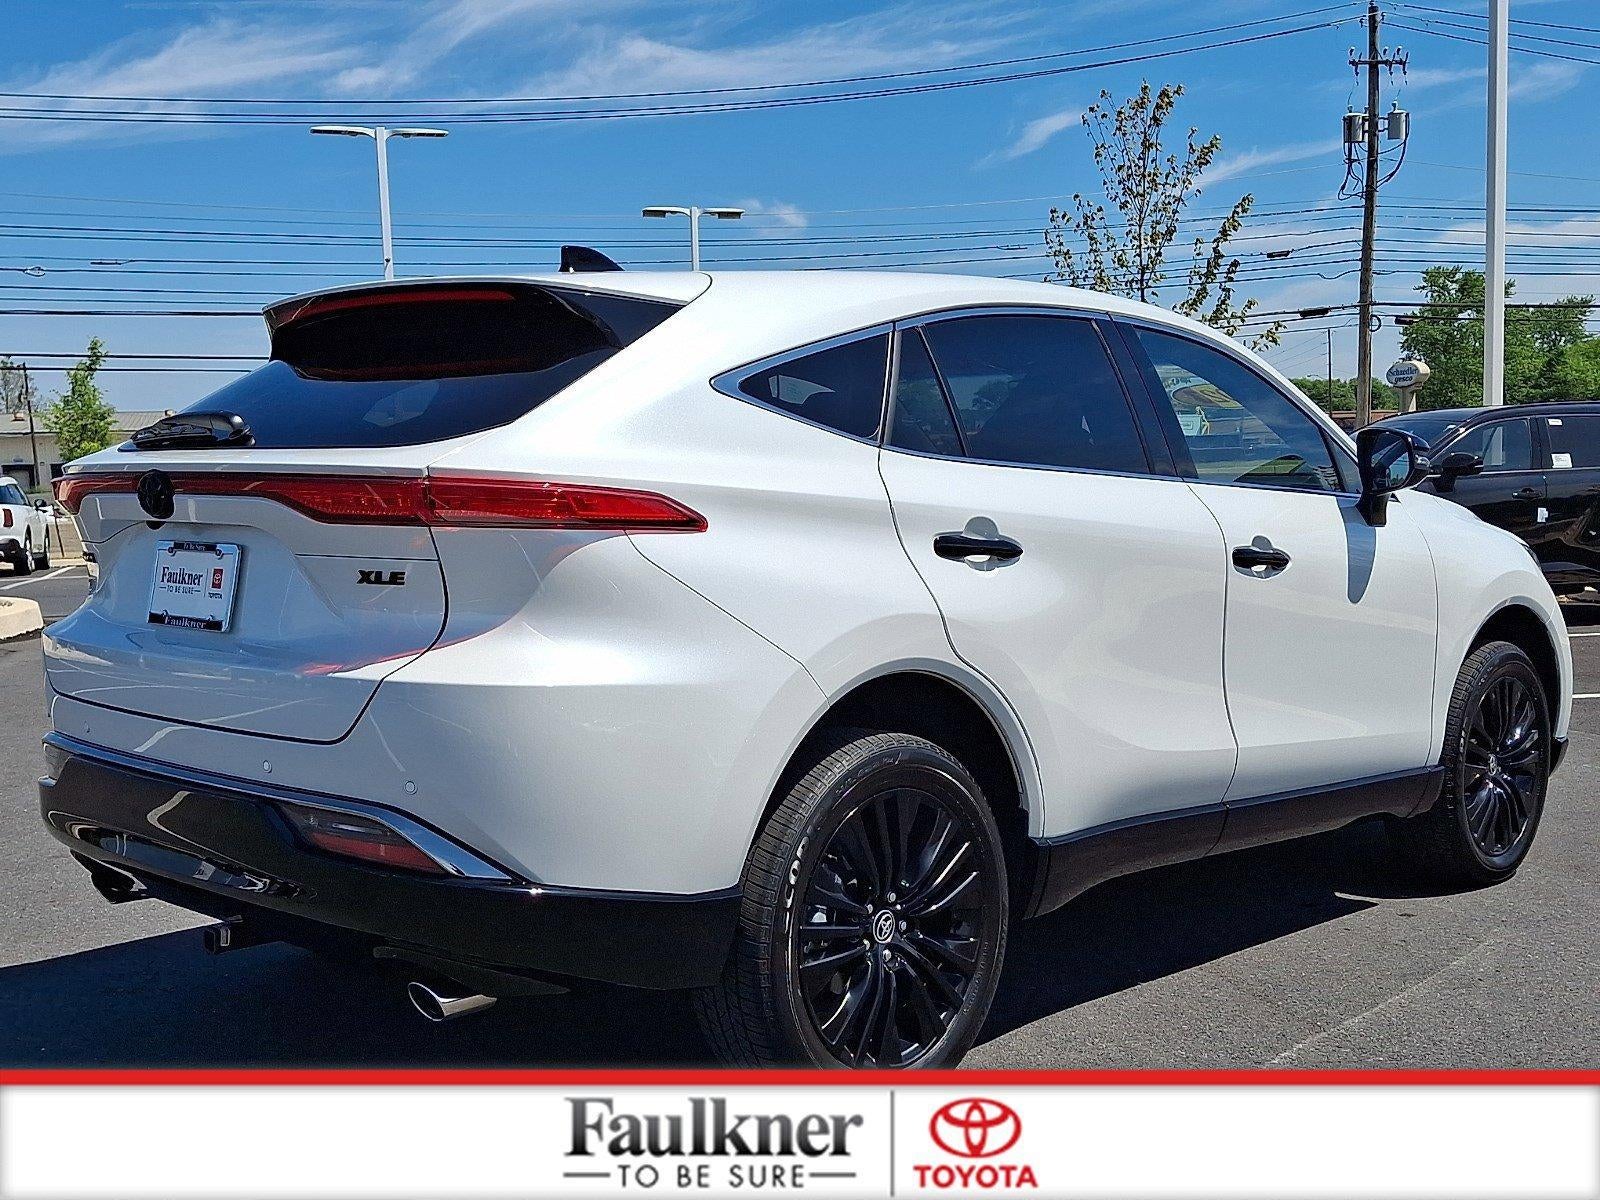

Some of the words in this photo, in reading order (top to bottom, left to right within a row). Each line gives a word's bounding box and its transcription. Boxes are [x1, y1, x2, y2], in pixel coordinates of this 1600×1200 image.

[161, 566, 203, 586] Faulkner
[356, 569, 406, 585] XLE
[167, 585, 174, 593] TO
[174, 585, 181, 594] BE
[181, 586, 194, 595] SURE
[165, 617, 206, 628] Faulkner
